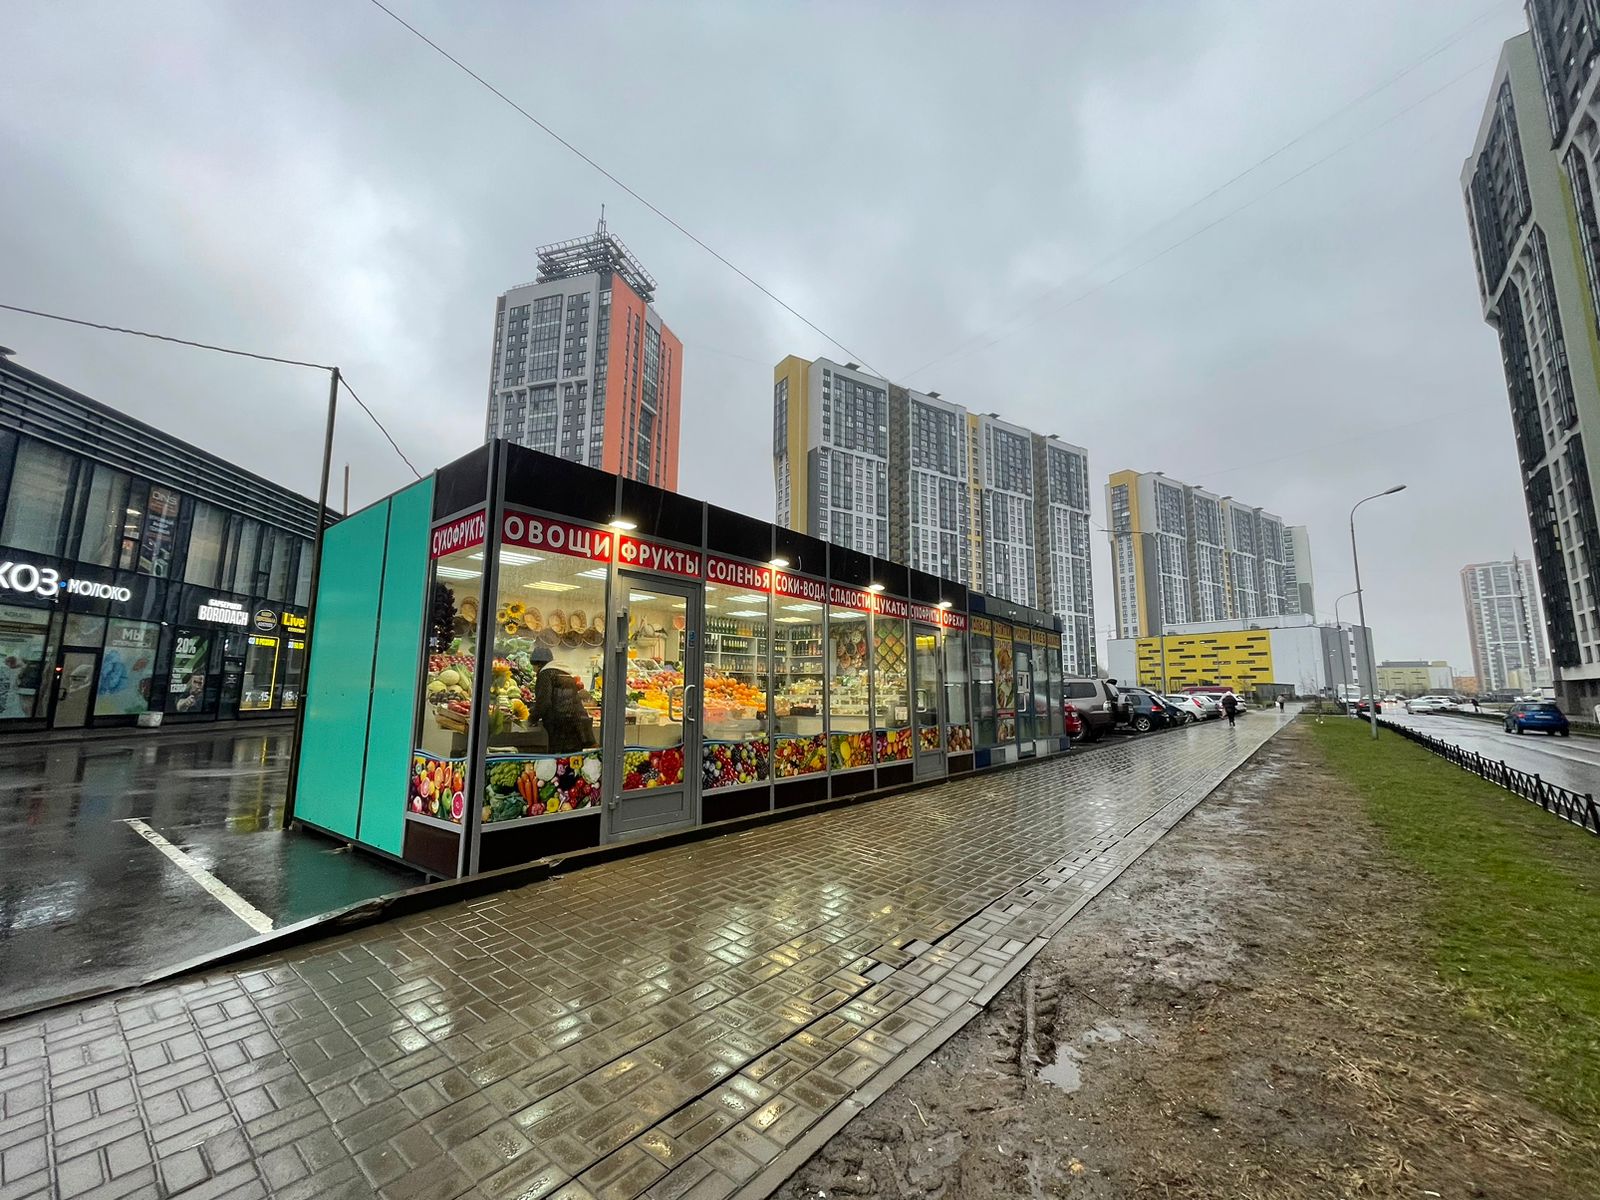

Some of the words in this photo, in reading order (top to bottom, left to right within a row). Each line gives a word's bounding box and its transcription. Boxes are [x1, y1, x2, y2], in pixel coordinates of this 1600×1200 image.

[504, 515, 610, 559] ОВОЩИ
[621, 541, 699, 576] ФРУКТЫ
[707, 558, 770, 588] СОЛЕНЬЯ
[67, 578, 131, 602] МОЛОКО
[829, 586, 871, 609] СЛАДОСТИ
[197, 604, 249, 627] BORODACH
[873, 594, 908, 617] ЦУКАТЫ
[943, 612, 965, 627] ОРЕХИ
[122, 628, 145, 642] МЫ
[175, 637, 197, 654] 20%
